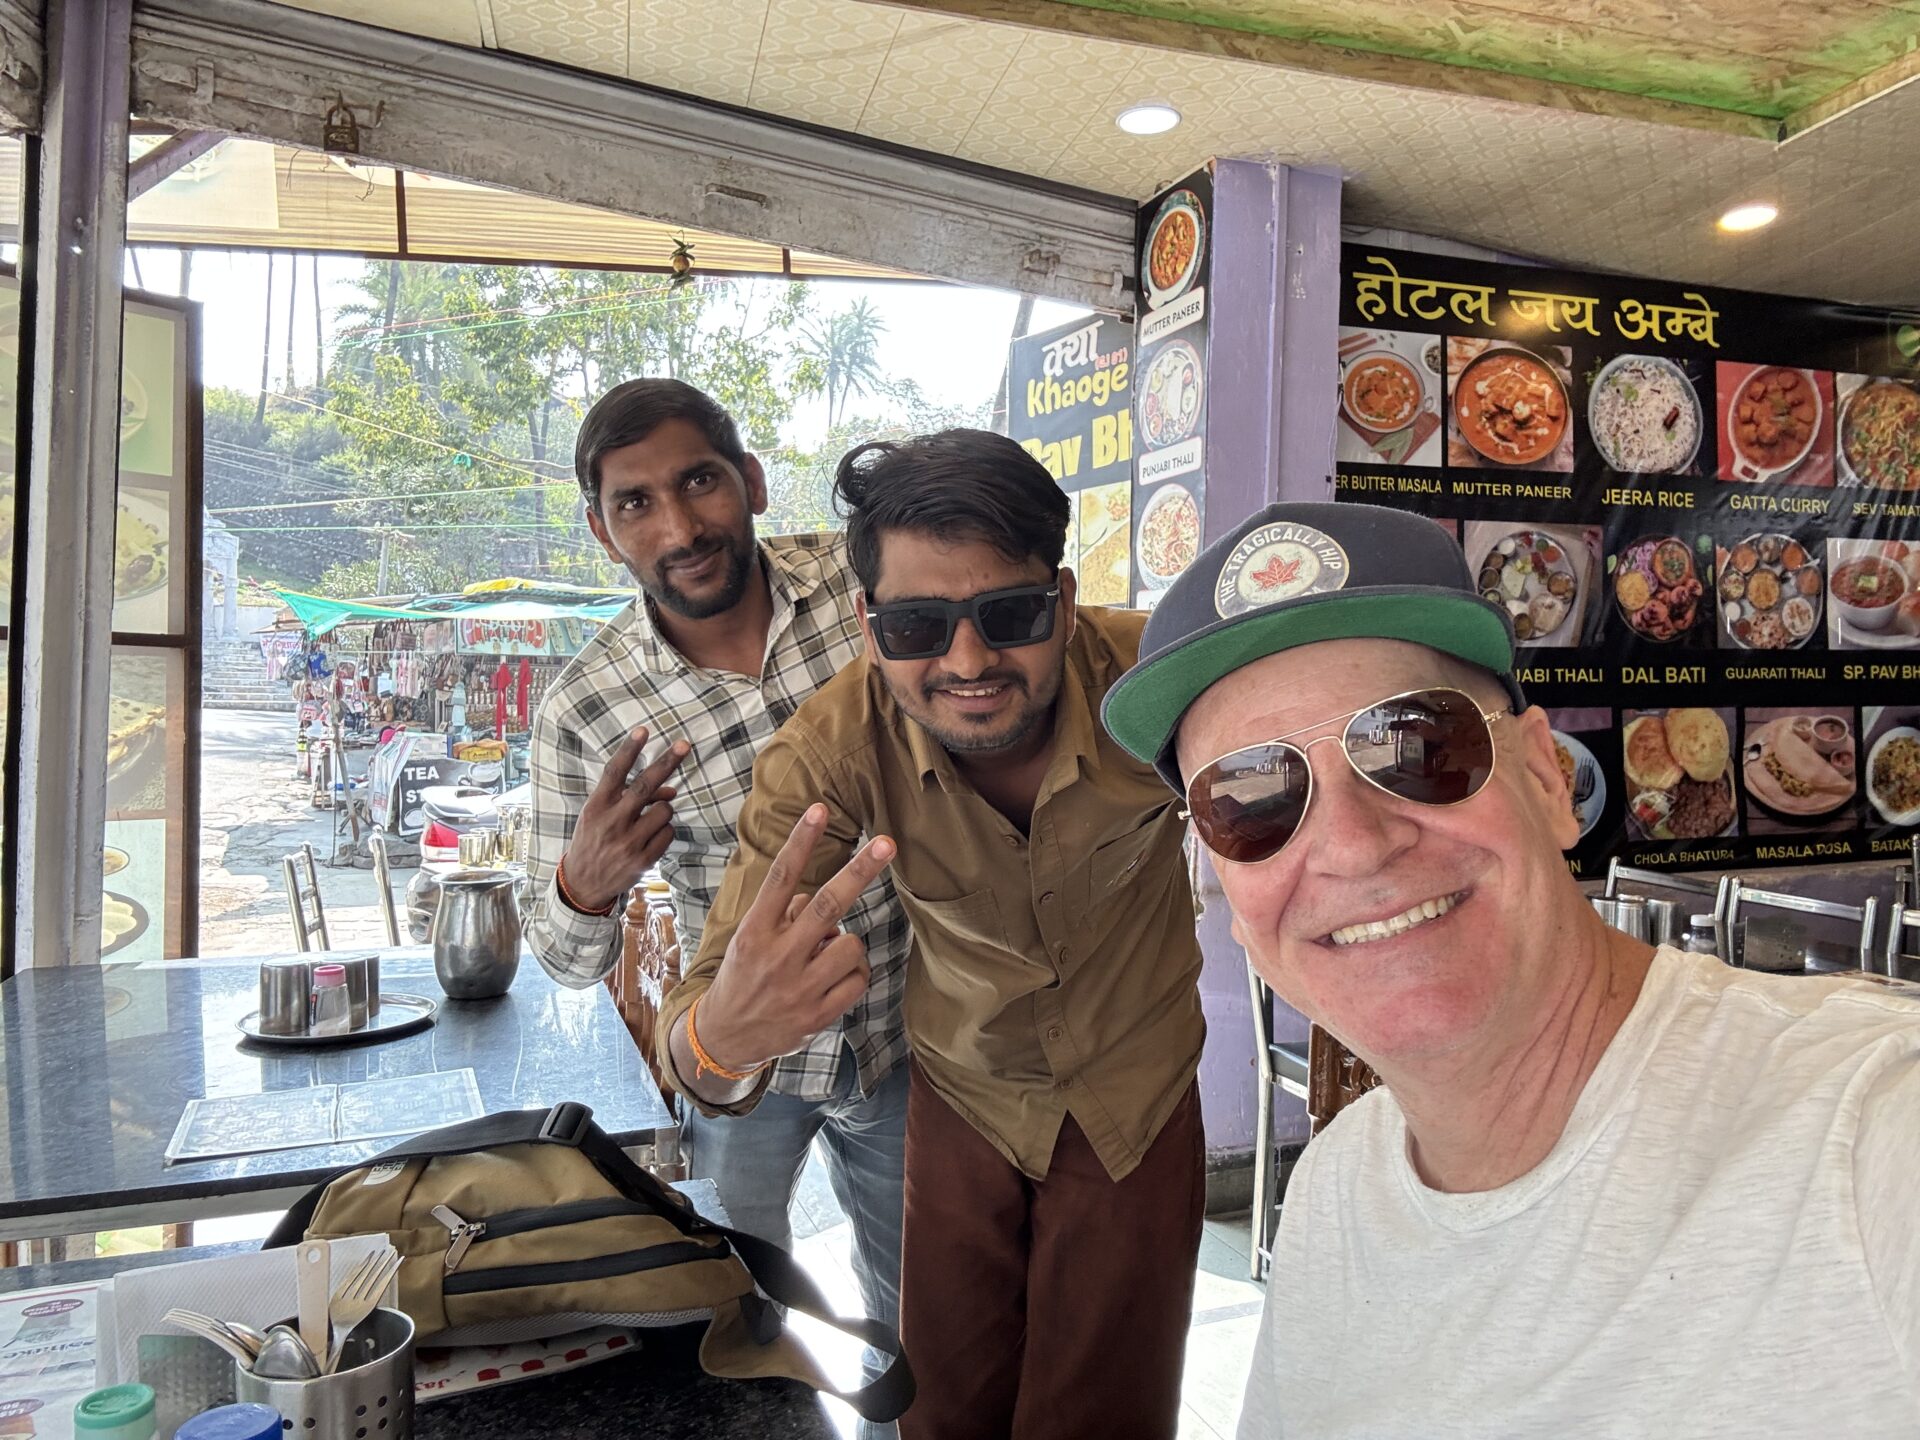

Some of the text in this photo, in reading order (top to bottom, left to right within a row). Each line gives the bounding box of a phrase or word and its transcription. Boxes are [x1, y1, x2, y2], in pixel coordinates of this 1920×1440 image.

[1352, 255, 1720, 347] होटल जय अम्बे
[1143, 300, 1200, 337] MUTTER PANEER
[1041, 319, 1104, 377] क्या
[1142, 452, 1194, 478] PUNJABI THALI
[1351, 475, 1395, 491] BUTTER
[1398, 478, 1442, 493] MASALA
[1453, 481, 1572, 499] MUTTER PANEER
[1602, 488, 1695, 508] JEERA RICE
[1730, 494, 1830, 513] GATTA CURRY
[1853, 502, 1878, 515] SEV
[1221, 528, 1342, 605] THE TRAGICALLY HIP
[1554, 668, 1603, 683] THALI
[1622, 667, 1706, 684] DAL BATI
[1725, 667, 1826, 680] GUJARATI THALI
[1843, 665, 1867, 680] SP.
[1870, 665, 1898, 679] PAV
[404, 765, 439, 781] TEA
[1634, 850, 1734, 865] CHOLA BHATURA
[1756, 842, 1852, 860] MASALA DOSA
